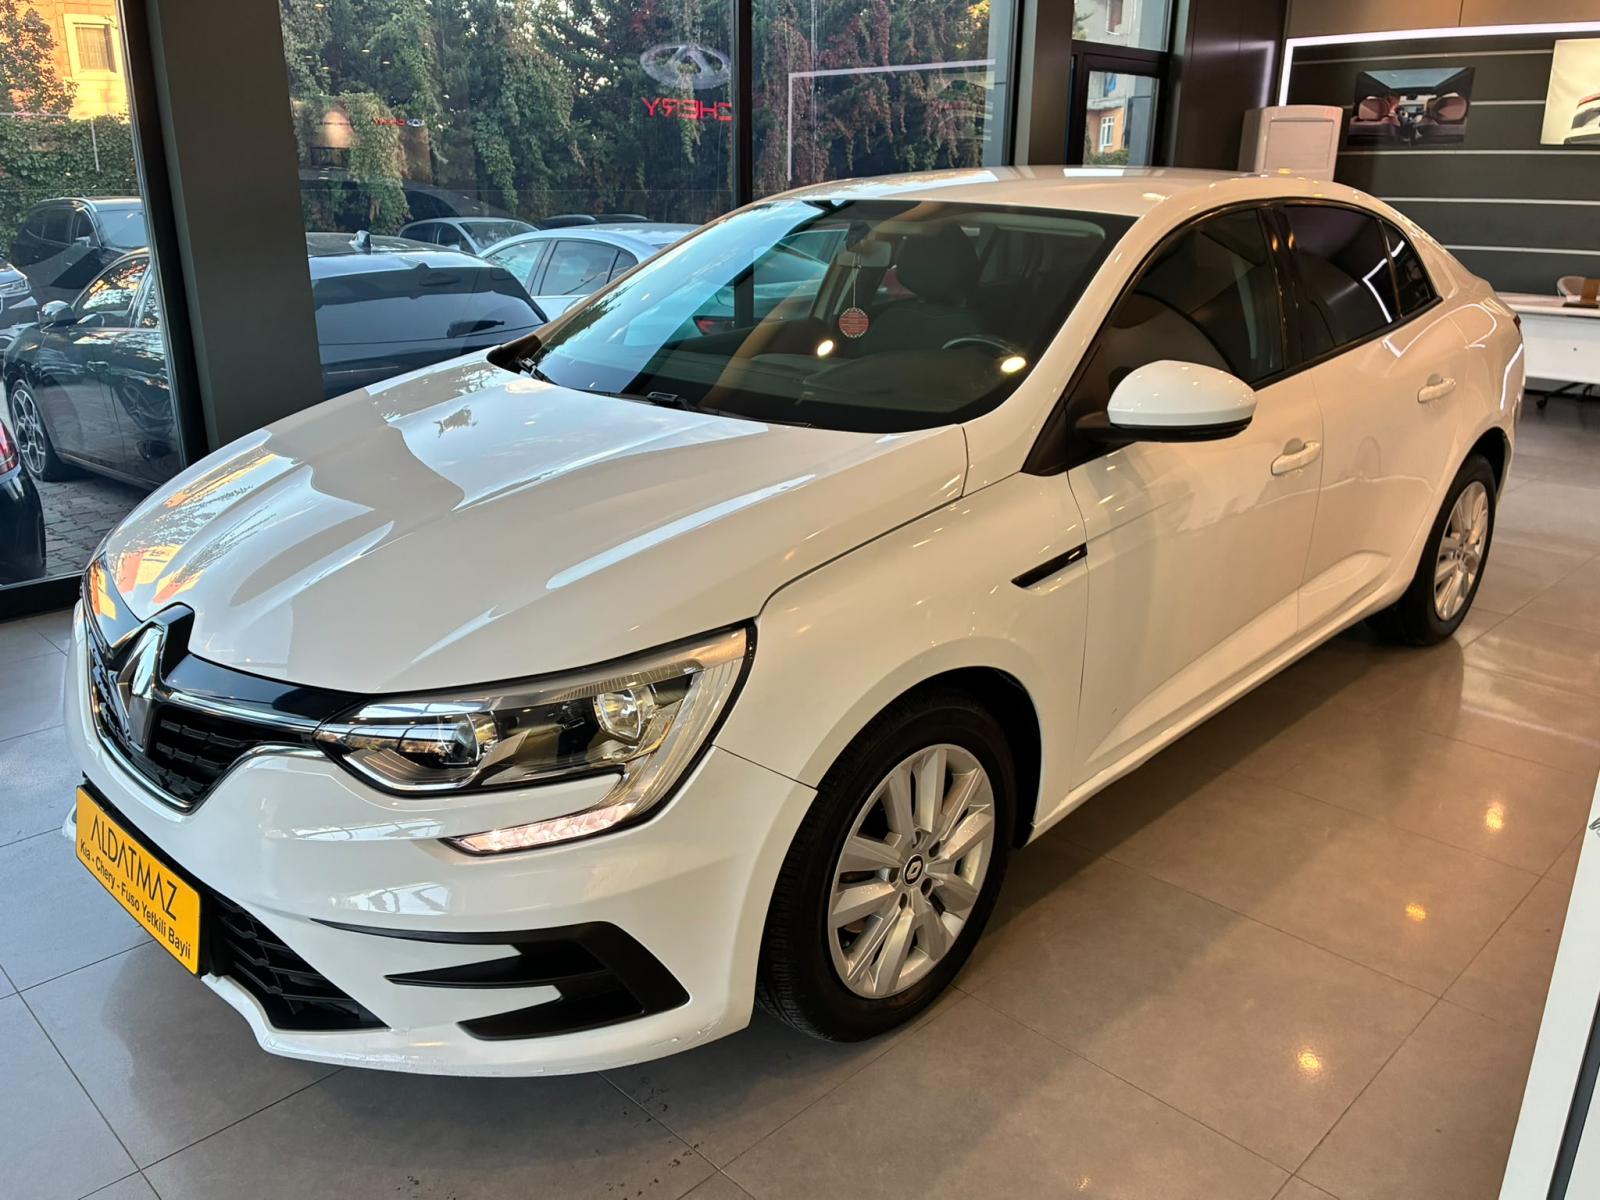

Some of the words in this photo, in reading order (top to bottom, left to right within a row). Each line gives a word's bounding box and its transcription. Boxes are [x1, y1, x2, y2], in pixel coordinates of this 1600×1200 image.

[90, 814, 178, 921] ALDATMAZ
[95, 855, 116, 890] Chery
[121, 884, 140, 913] Fuso
[141, 901, 167, 939] Yetkili
[169, 927, 191, 960] Bayii
